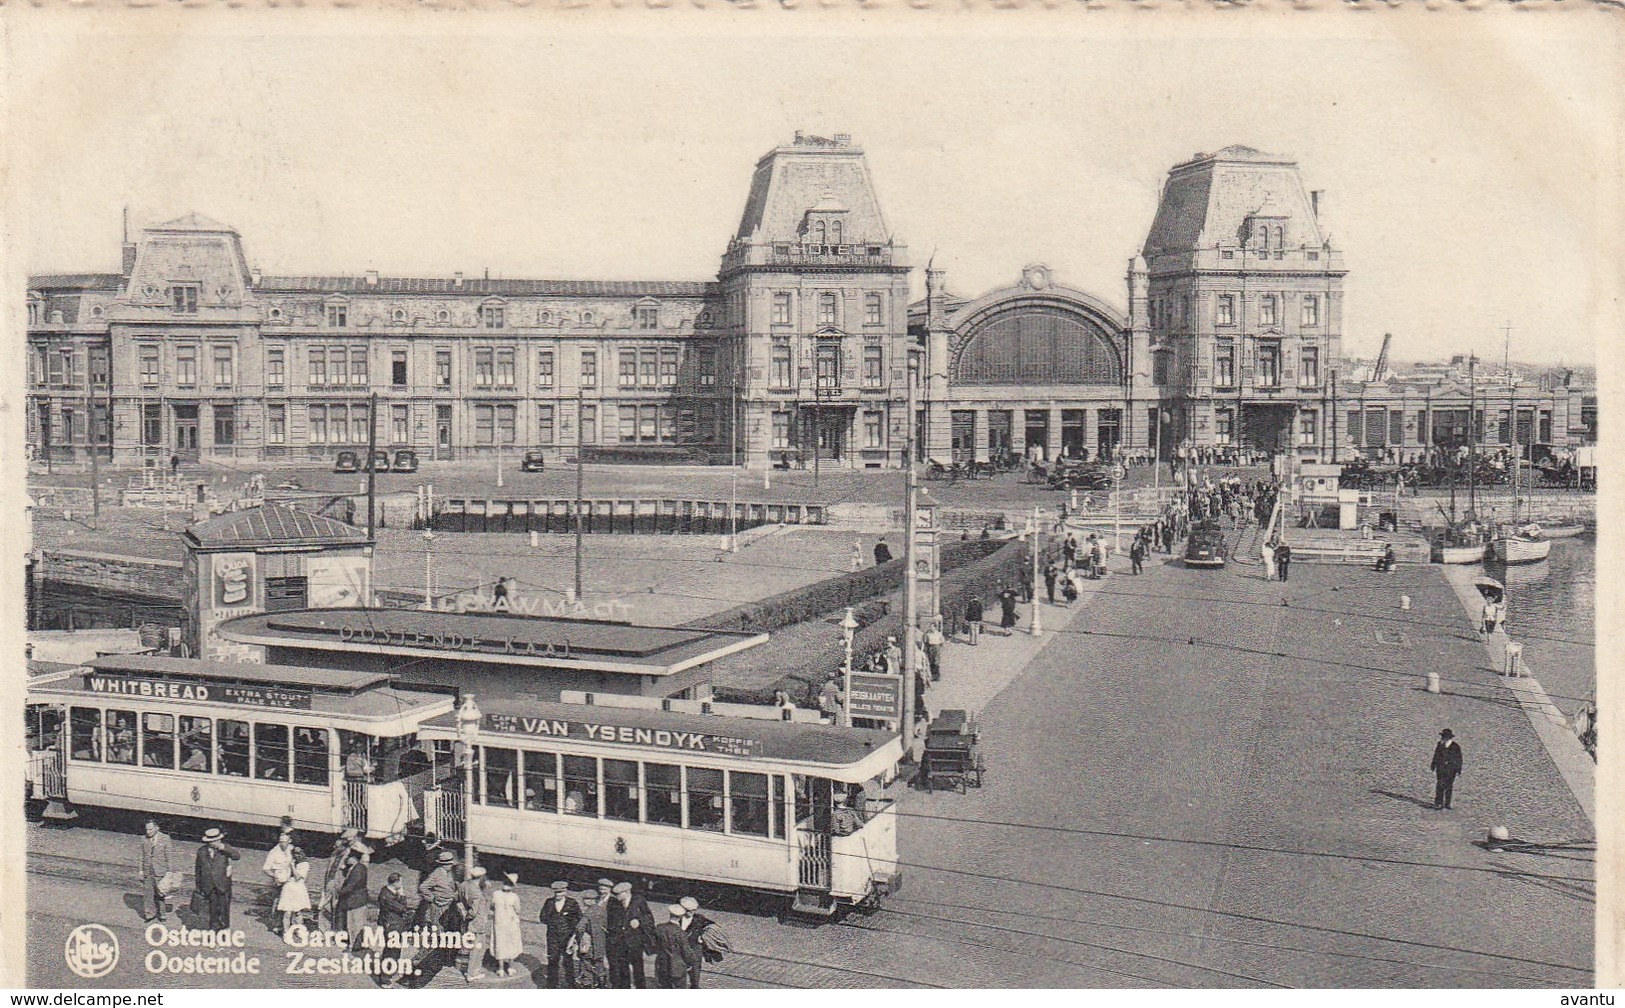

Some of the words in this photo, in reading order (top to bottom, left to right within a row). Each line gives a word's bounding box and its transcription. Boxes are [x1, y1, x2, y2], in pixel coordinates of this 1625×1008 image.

[792, 244, 866, 255] HOTEL
[90, 677, 209, 701] WHITBREAD
[225, 688, 261, 699] EXTRA
[237, 697, 265, 706] PALE
[522, 717, 569, 737] VAN
[584, 723, 706, 750] YSENDYK
